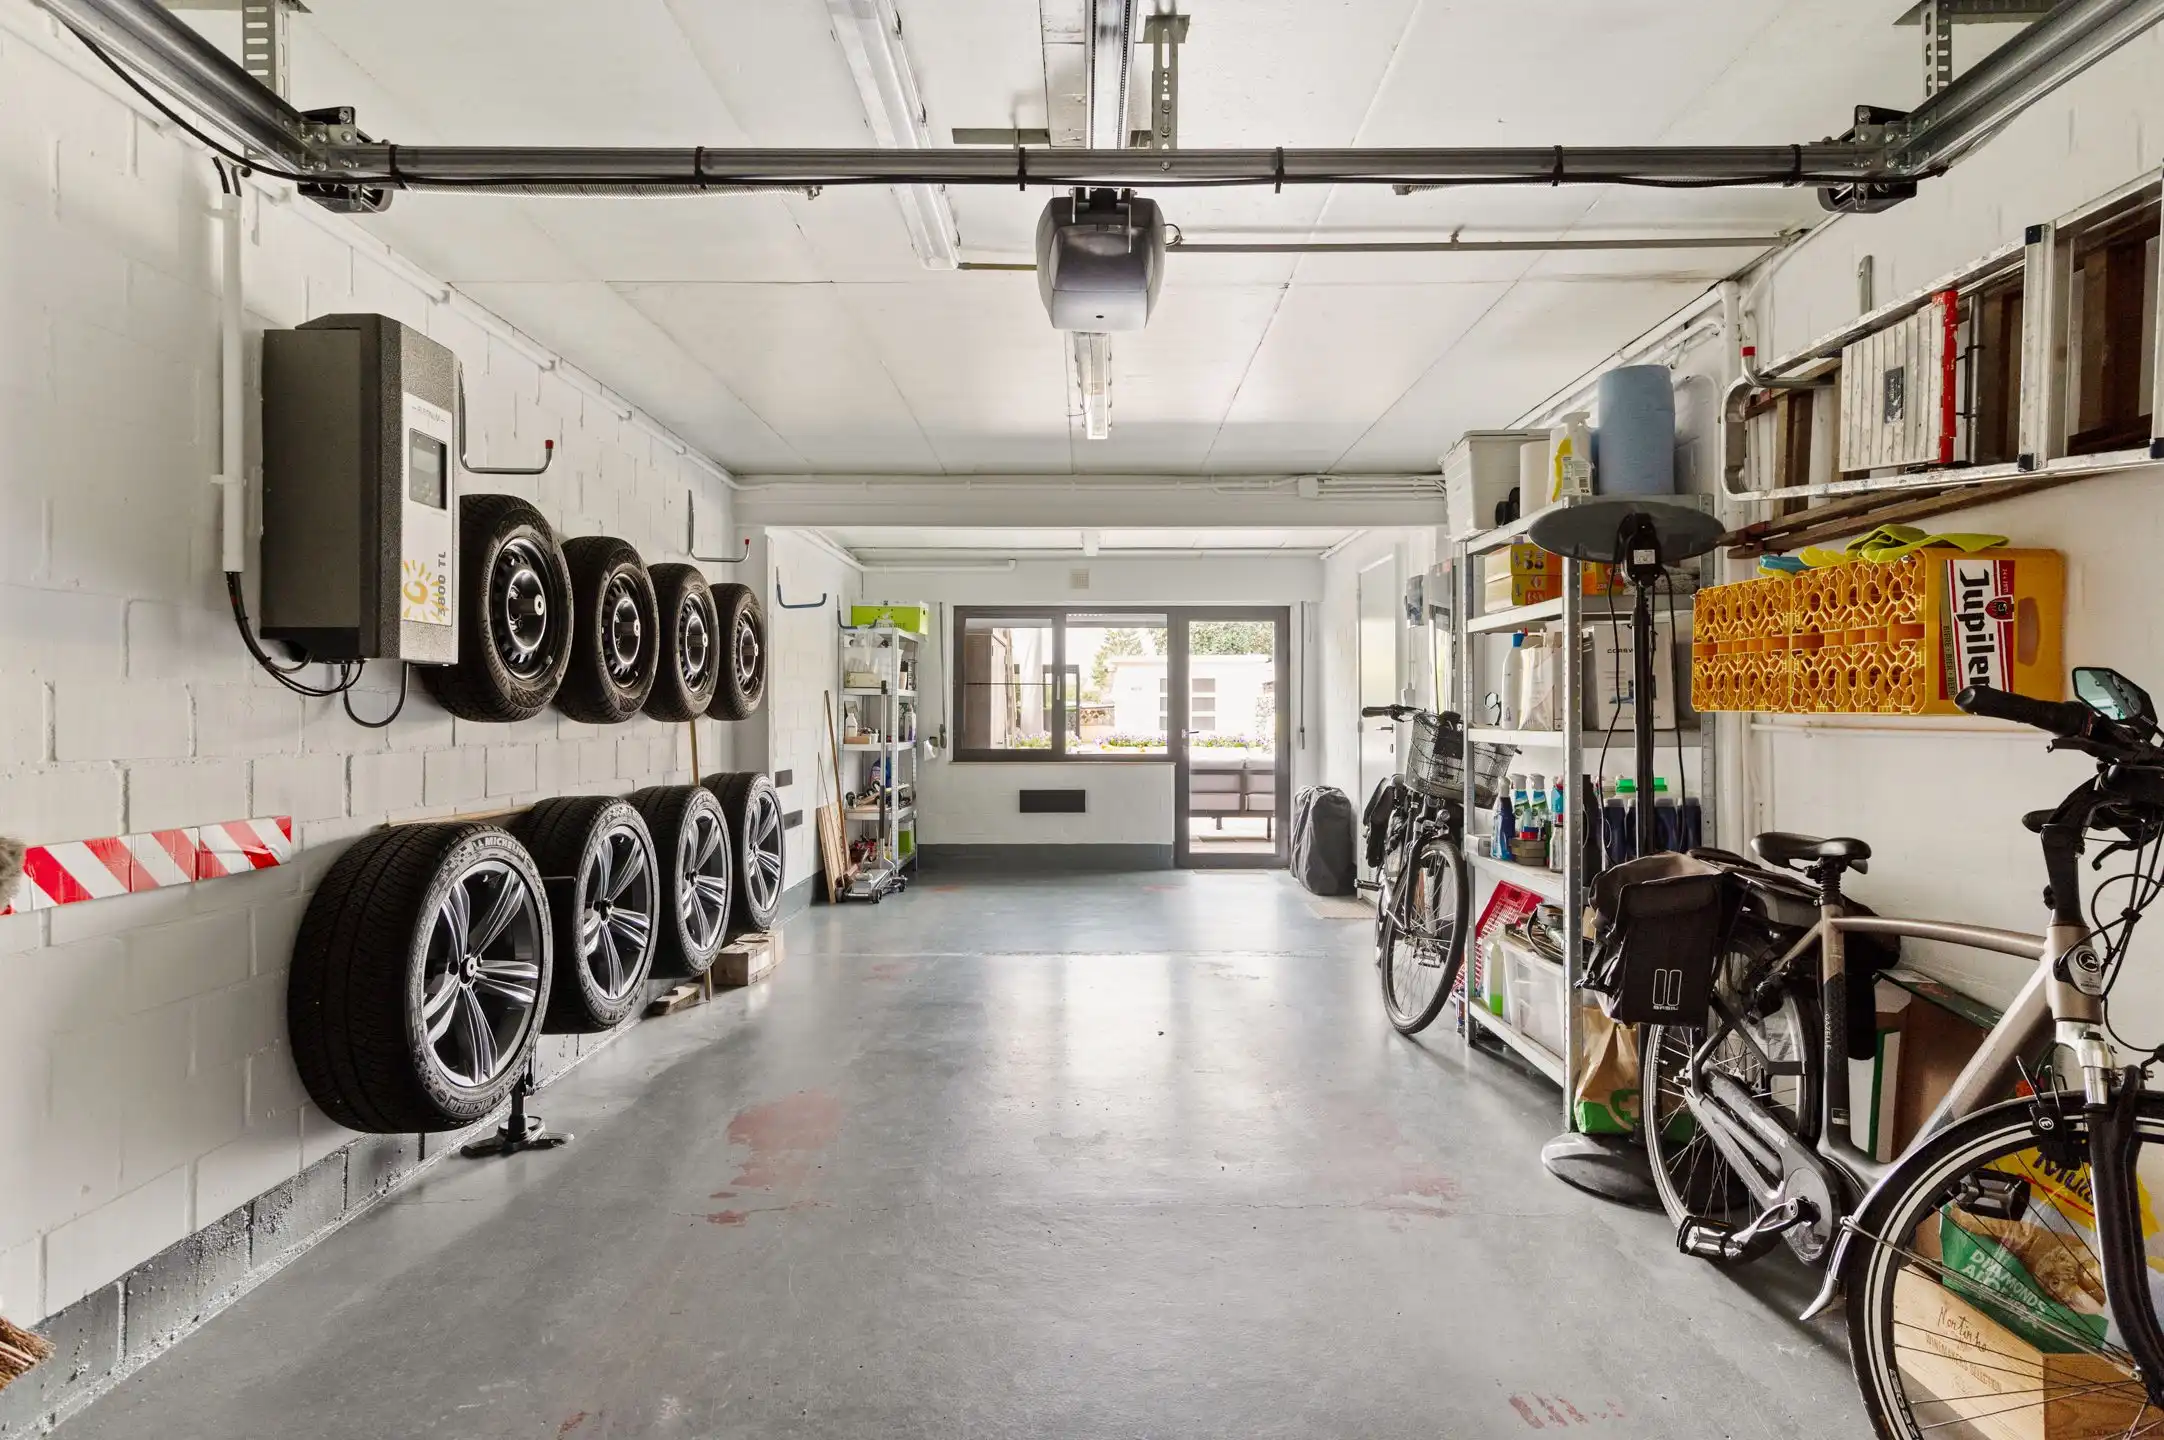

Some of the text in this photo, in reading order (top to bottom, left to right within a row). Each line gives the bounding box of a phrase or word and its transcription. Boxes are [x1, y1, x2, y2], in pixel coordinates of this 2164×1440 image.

[437, 552, 446, 617] 3800 TL
[485, 837, 528, 863] MICHELIN
